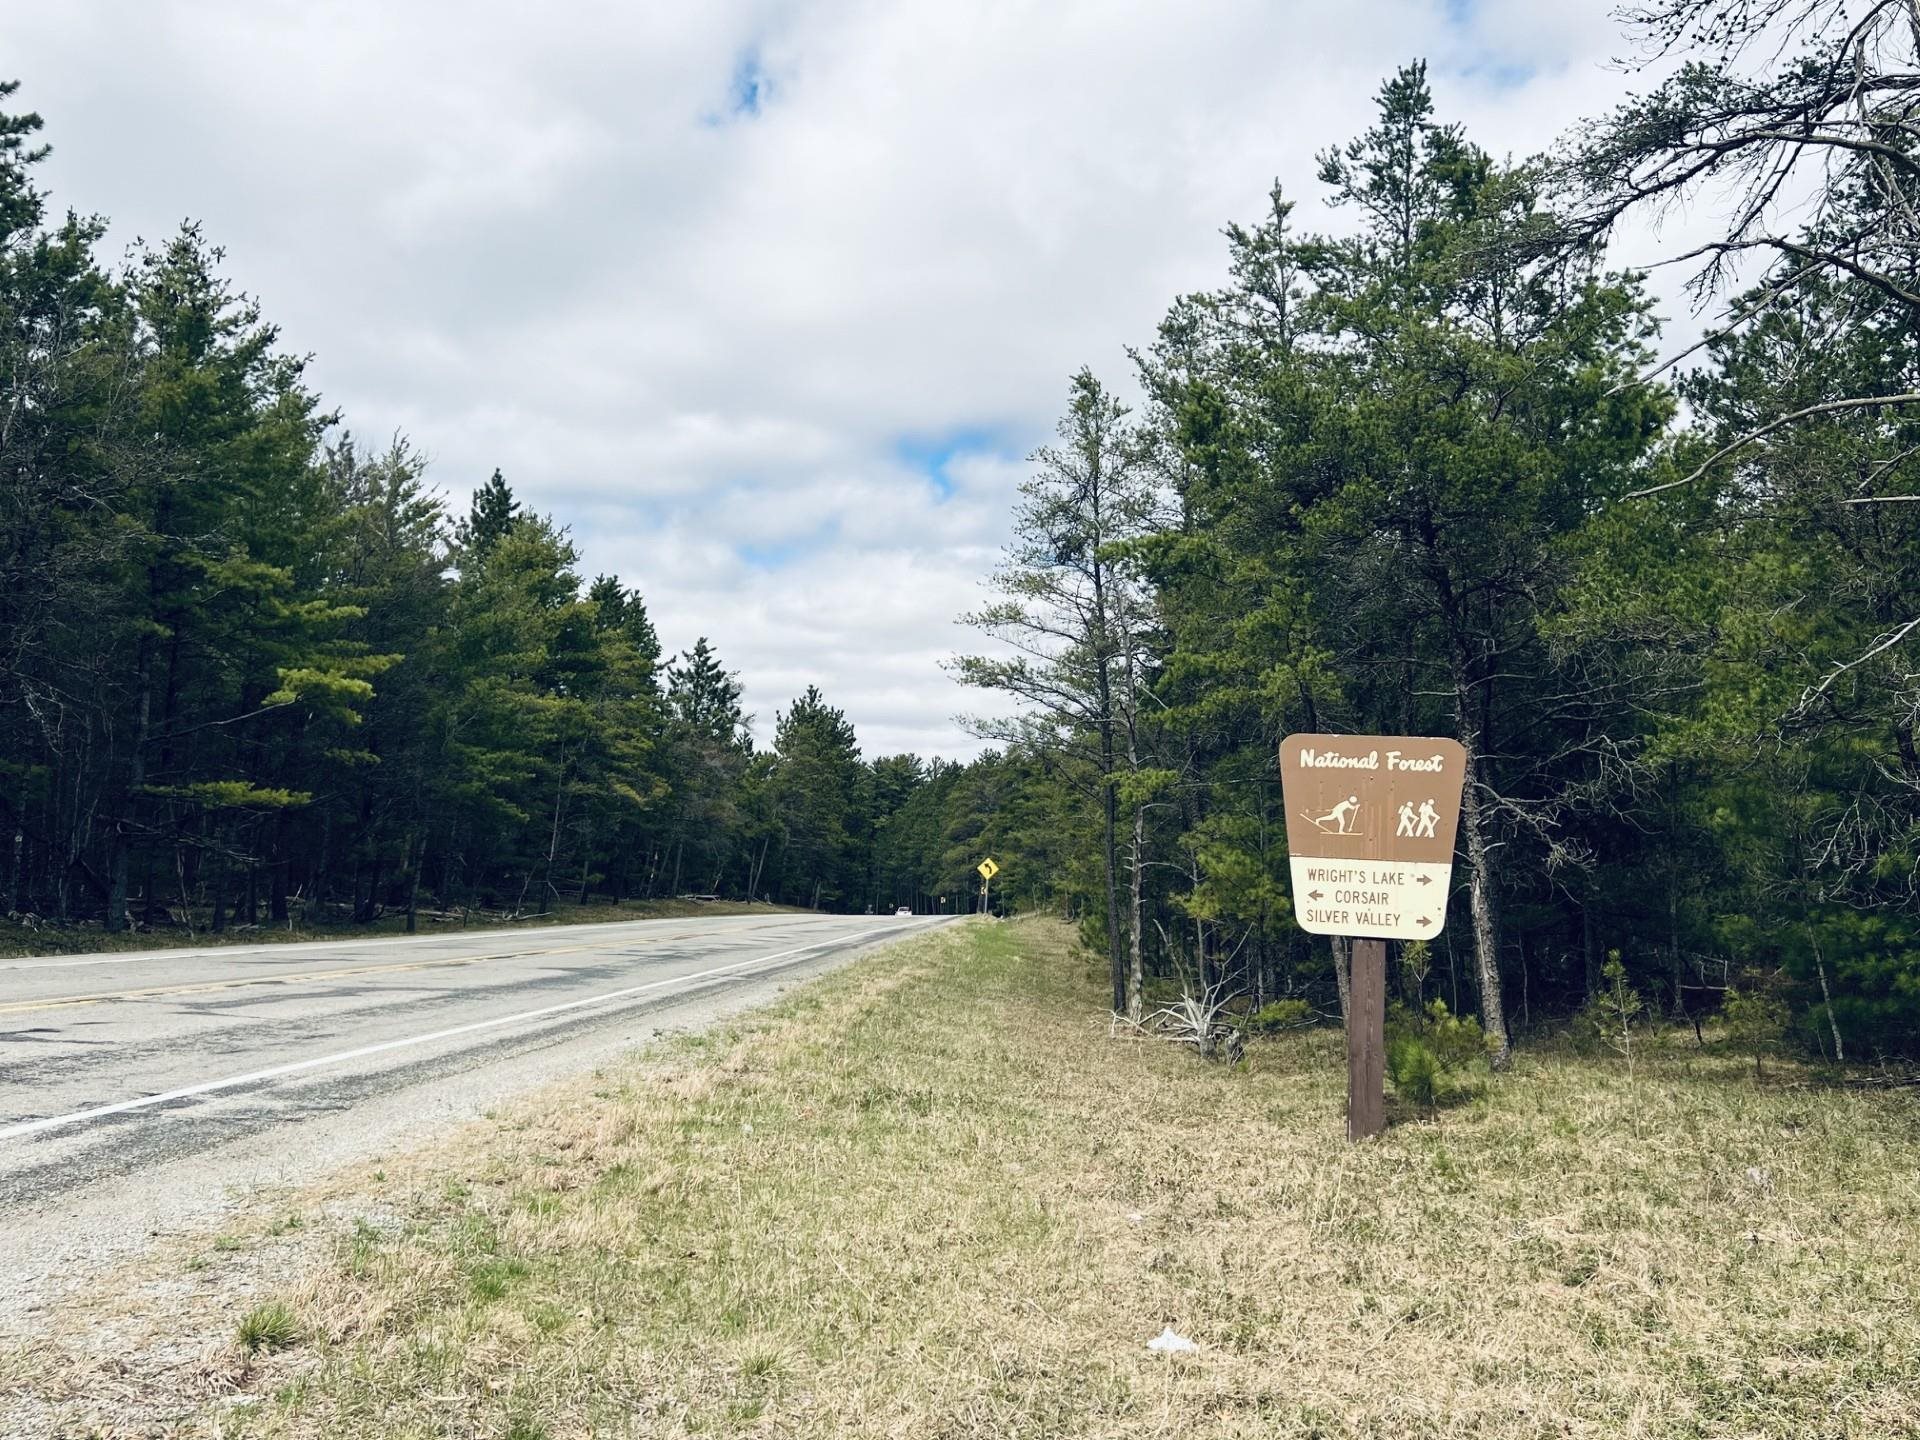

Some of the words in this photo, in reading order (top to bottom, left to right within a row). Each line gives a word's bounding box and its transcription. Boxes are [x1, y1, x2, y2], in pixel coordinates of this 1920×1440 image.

[1300, 748, 1379, 770] National
[1386, 751, 1444, 772] Forest
[1307, 868, 1366, 884] WRIGHT'S
[1372, 871, 1405, 886] LAKE
[1335, 890, 1389, 905] CORSAIR
[1306, 909, 1349, 924] SILVER
[1355, 911, 1401, 927] VALLEY
